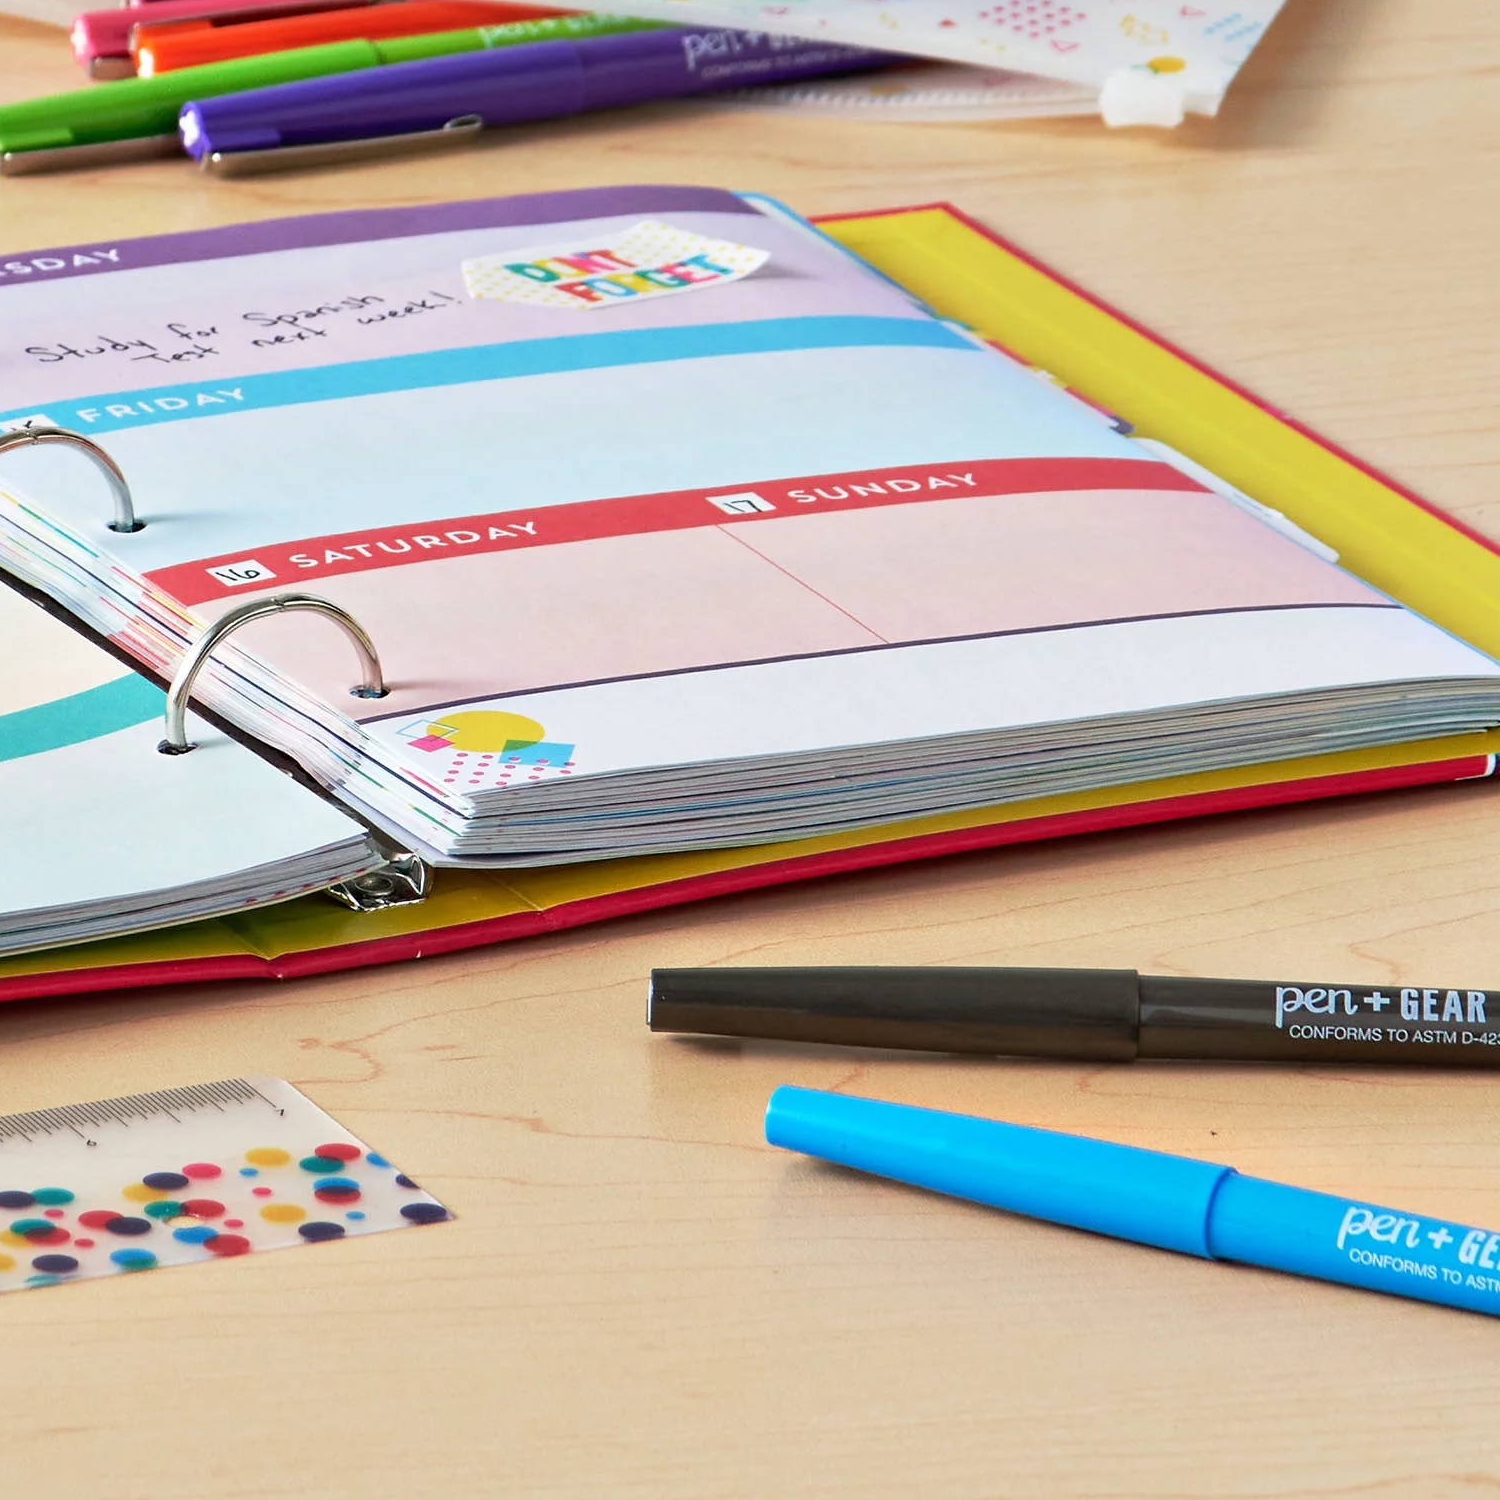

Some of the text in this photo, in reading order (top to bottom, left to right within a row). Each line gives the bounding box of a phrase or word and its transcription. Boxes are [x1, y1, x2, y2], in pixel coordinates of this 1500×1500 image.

[682, 30, 743, 71] pen
[554, 253, 736, 303] FORGET
[24, 293, 385, 363] Study for Spanish
[130, 290, 463, 365] Test next week!
[75, 387, 247, 424] FRIDAY
[215, 473, 977, 581] 16 SATURDAY 17 SUNDAY
[1275, 986, 1358, 1028] pen
[1400, 988, 1487, 1023] GEAR
[1289, 1024, 1383, 1042] CONFORMS
[1387, 1028, 1409, 1043] TO
[1411, 1029, 1457, 1044] ASTM
[1336, 1206, 1420, 1250] pen
[1458, 1229, 1500, 1270] GE
[1349, 1248, 1438, 1280] CONFORMS
[1441, 1267, 1462, 1285] TO
